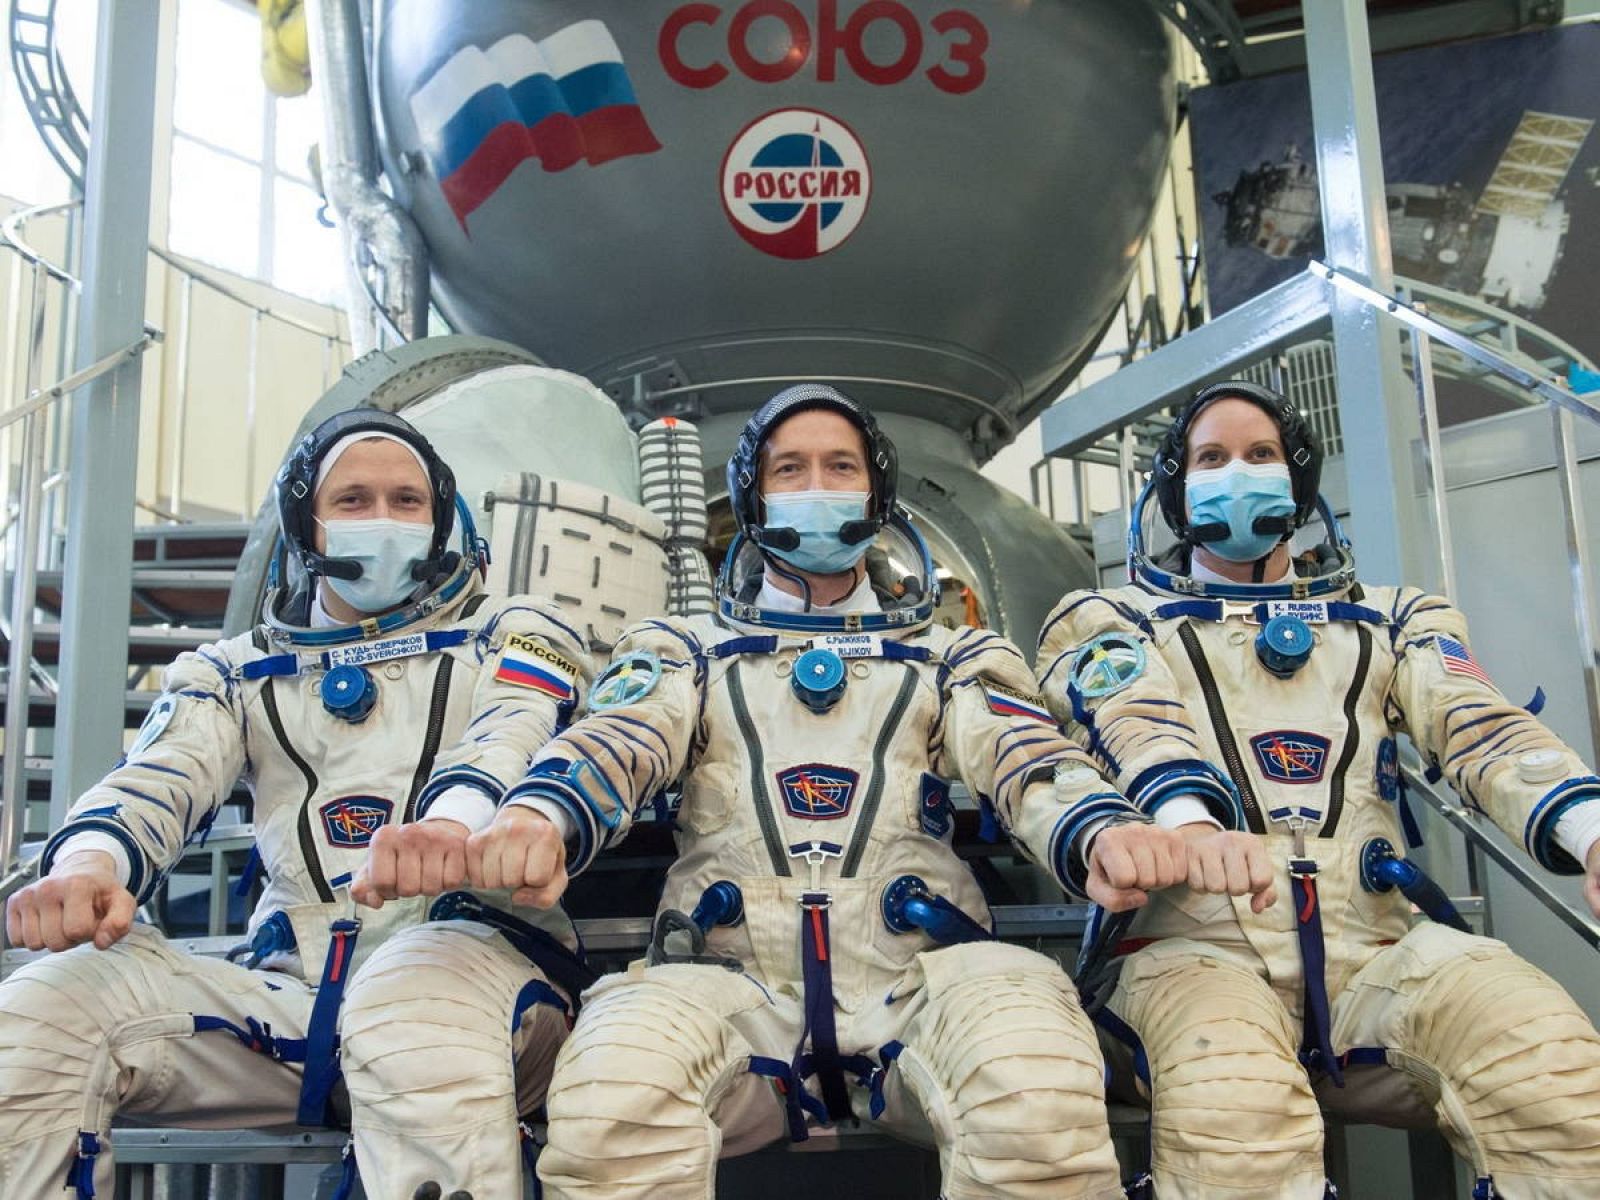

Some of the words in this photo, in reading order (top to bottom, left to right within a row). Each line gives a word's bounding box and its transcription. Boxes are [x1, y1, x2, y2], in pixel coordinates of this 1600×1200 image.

[658, 0, 989, 95] СОЮЗ
[733, 170, 861, 199] РОССИЯ
[1287, 603, 1323, 611] RUBINS
[510, 636, 577, 676] РОССИЯ
[838, 647, 872, 656] RIJIKOV
